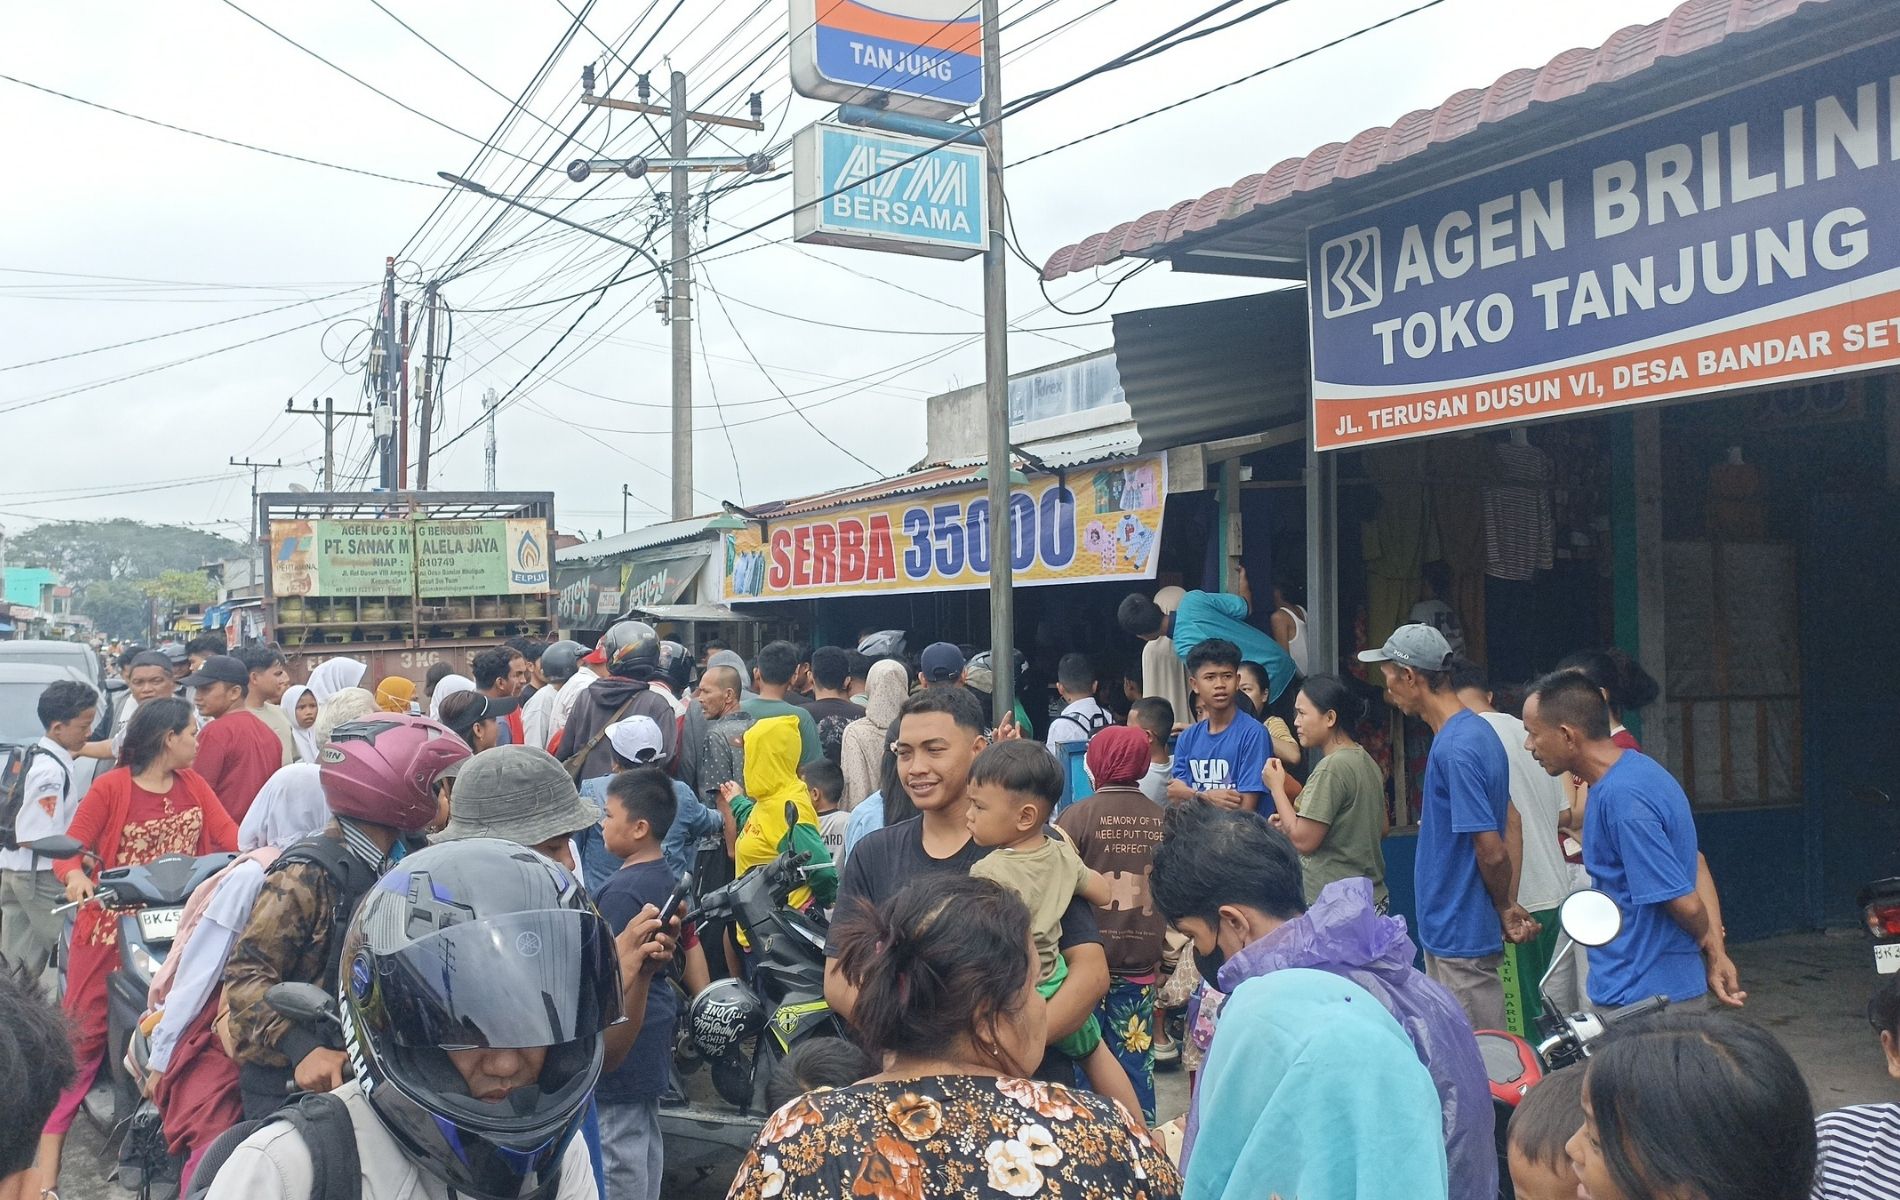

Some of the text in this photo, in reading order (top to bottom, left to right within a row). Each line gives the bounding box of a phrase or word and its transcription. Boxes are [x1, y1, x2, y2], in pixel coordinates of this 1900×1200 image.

[849, 41, 952, 82] TANJUNG
[833, 144, 968, 208] ATM
[1393, 73, 1900, 293] AGEN BRILIN
[833, 194, 971, 233] BERSAMA
[1372, 207, 1869, 366] TOKO TANJUNG
[1335, 415, 1363, 437] JL.
[1368, 394, 1468, 431] TERUSAN
[1475, 378, 1561, 413] DUSUN
[1568, 371, 1604, 399] VI,
[1612, 355, 1689, 390] DESA
[1697, 330, 1833, 376] BANDAR
[341, 525, 367, 536] AGEN
[371, 525, 390, 536] LPG
[769, 484, 1077, 590] SERBA 35000
[324, 539, 344, 554] PT.
[348, 539, 395, 554] SANAK
[467, 537, 499, 554] JAYA
[514, 573, 546, 583] ELPIJI
[401, 652, 440, 669] 3 KG
[1189, 758, 1230, 783] DEAD
[1100, 815, 1137, 825] MEMORY
[1139, 816, 1150, 825] OF
[1123, 829, 1141, 839] PUT
[1111, 843, 1148, 854] PERFECT
[143, 912, 162, 925] BK
